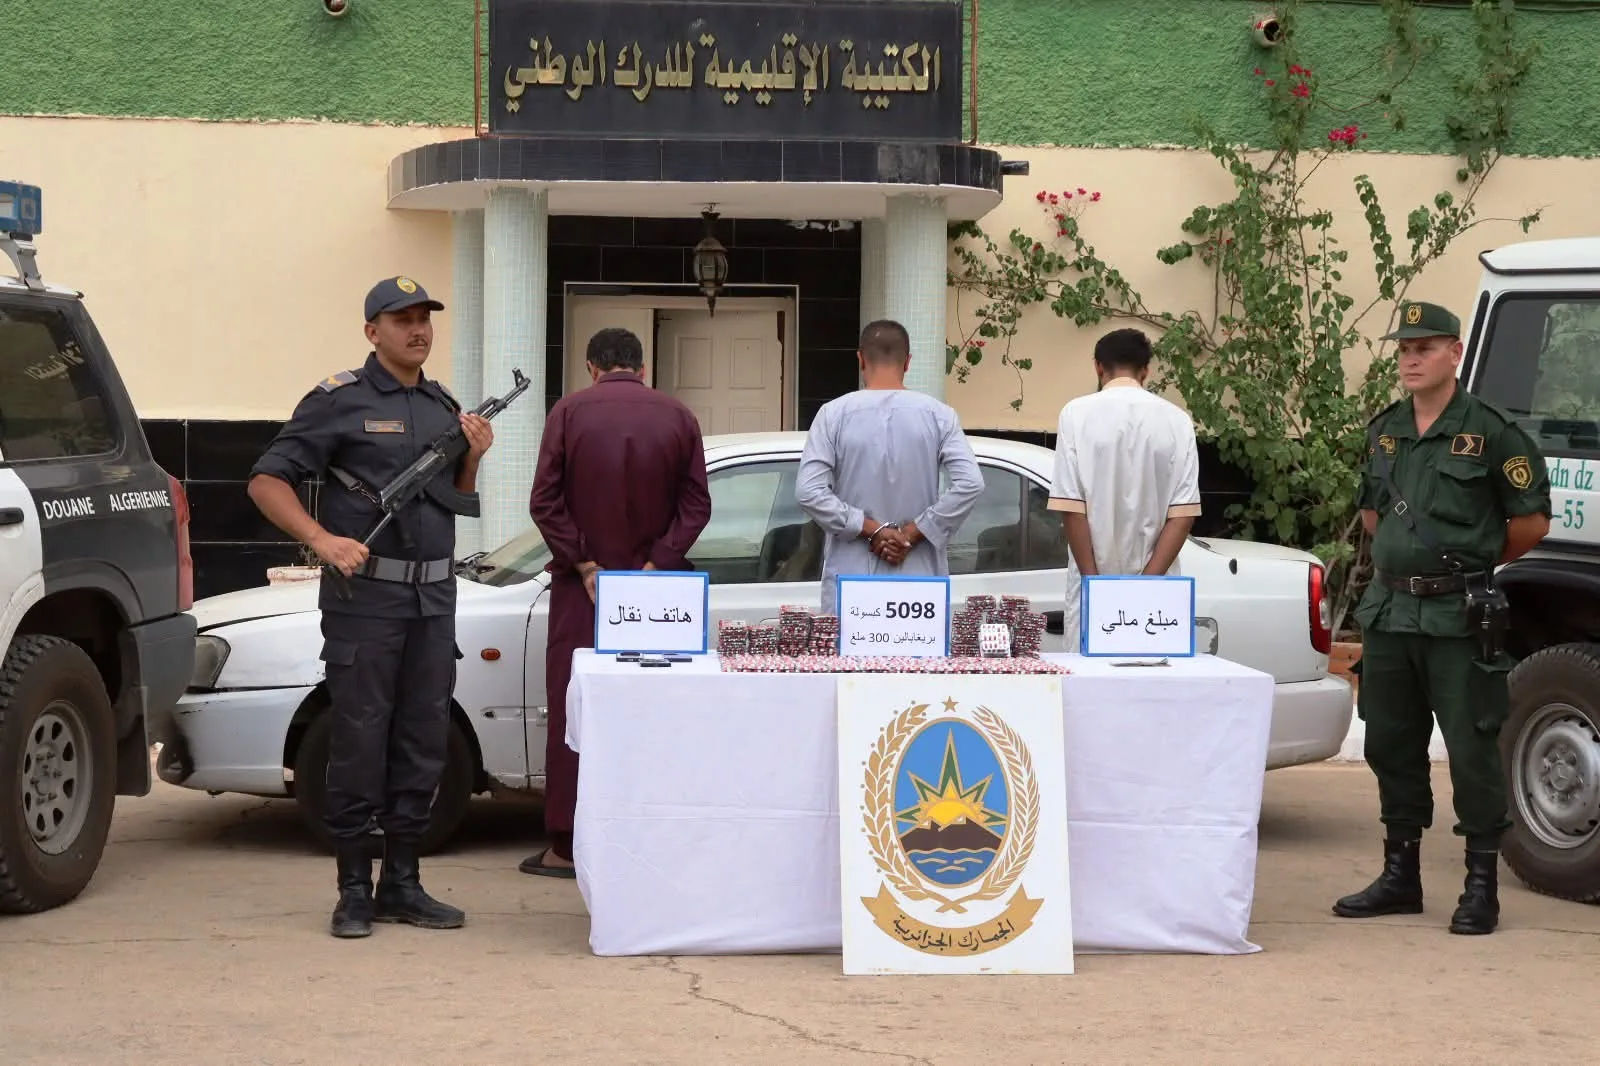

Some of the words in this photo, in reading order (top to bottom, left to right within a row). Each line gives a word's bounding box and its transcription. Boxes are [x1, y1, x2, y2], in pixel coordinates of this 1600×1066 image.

[504, 35, 606, 113] الوطني
[613, 40, 696, 102] للدرك
[699, 33, 829, 106] الإقليمية
[840, 39, 940, 109] الكتيبة
[43, 497, 96, 520] DOUANE
[109, 490, 171, 512] ALGERIENNE
[608, 604, 642, 626] نقال
[648, 607, 692, 624] هاتف
[885, 601, 936, 620] 5098
[1101, 609, 1139, 635] مالي
[1144, 609, 1179, 635] مبلغ
[850, 631, 866, 646] ملغ
[868, 632, 890, 643] 300
[893, 914, 952, 951] الجزائرية
[957, 918, 1015, 951] الجمارك
